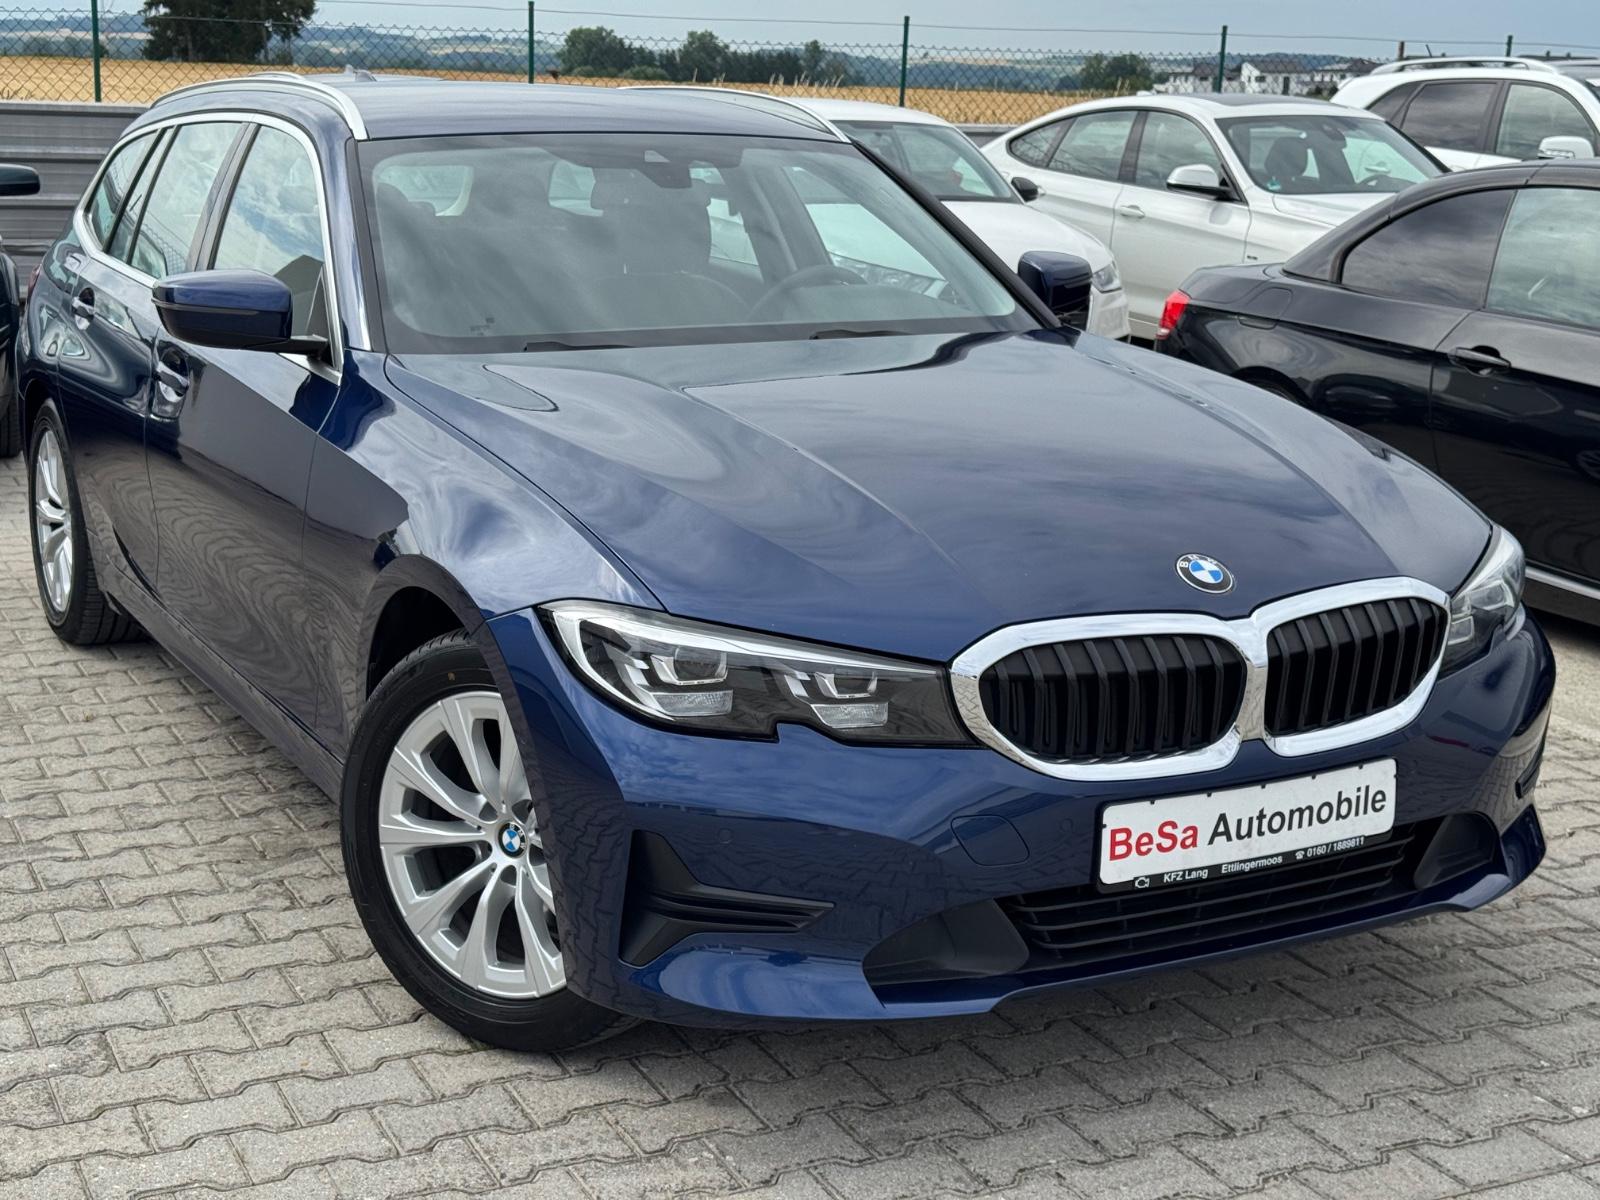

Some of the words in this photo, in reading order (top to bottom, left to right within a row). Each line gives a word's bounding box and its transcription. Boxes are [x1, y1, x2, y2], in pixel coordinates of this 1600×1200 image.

[1109, 820, 1198, 861] BeSa
[1208, 784, 1387, 845] Automobile
[1163, 872, 1183, 883] KFZ
[1185, 869, 1208, 880] Lang
[1221, 855, 1283, 874] Ettlingermoos
[1306, 845, 1327, 857] 0160
